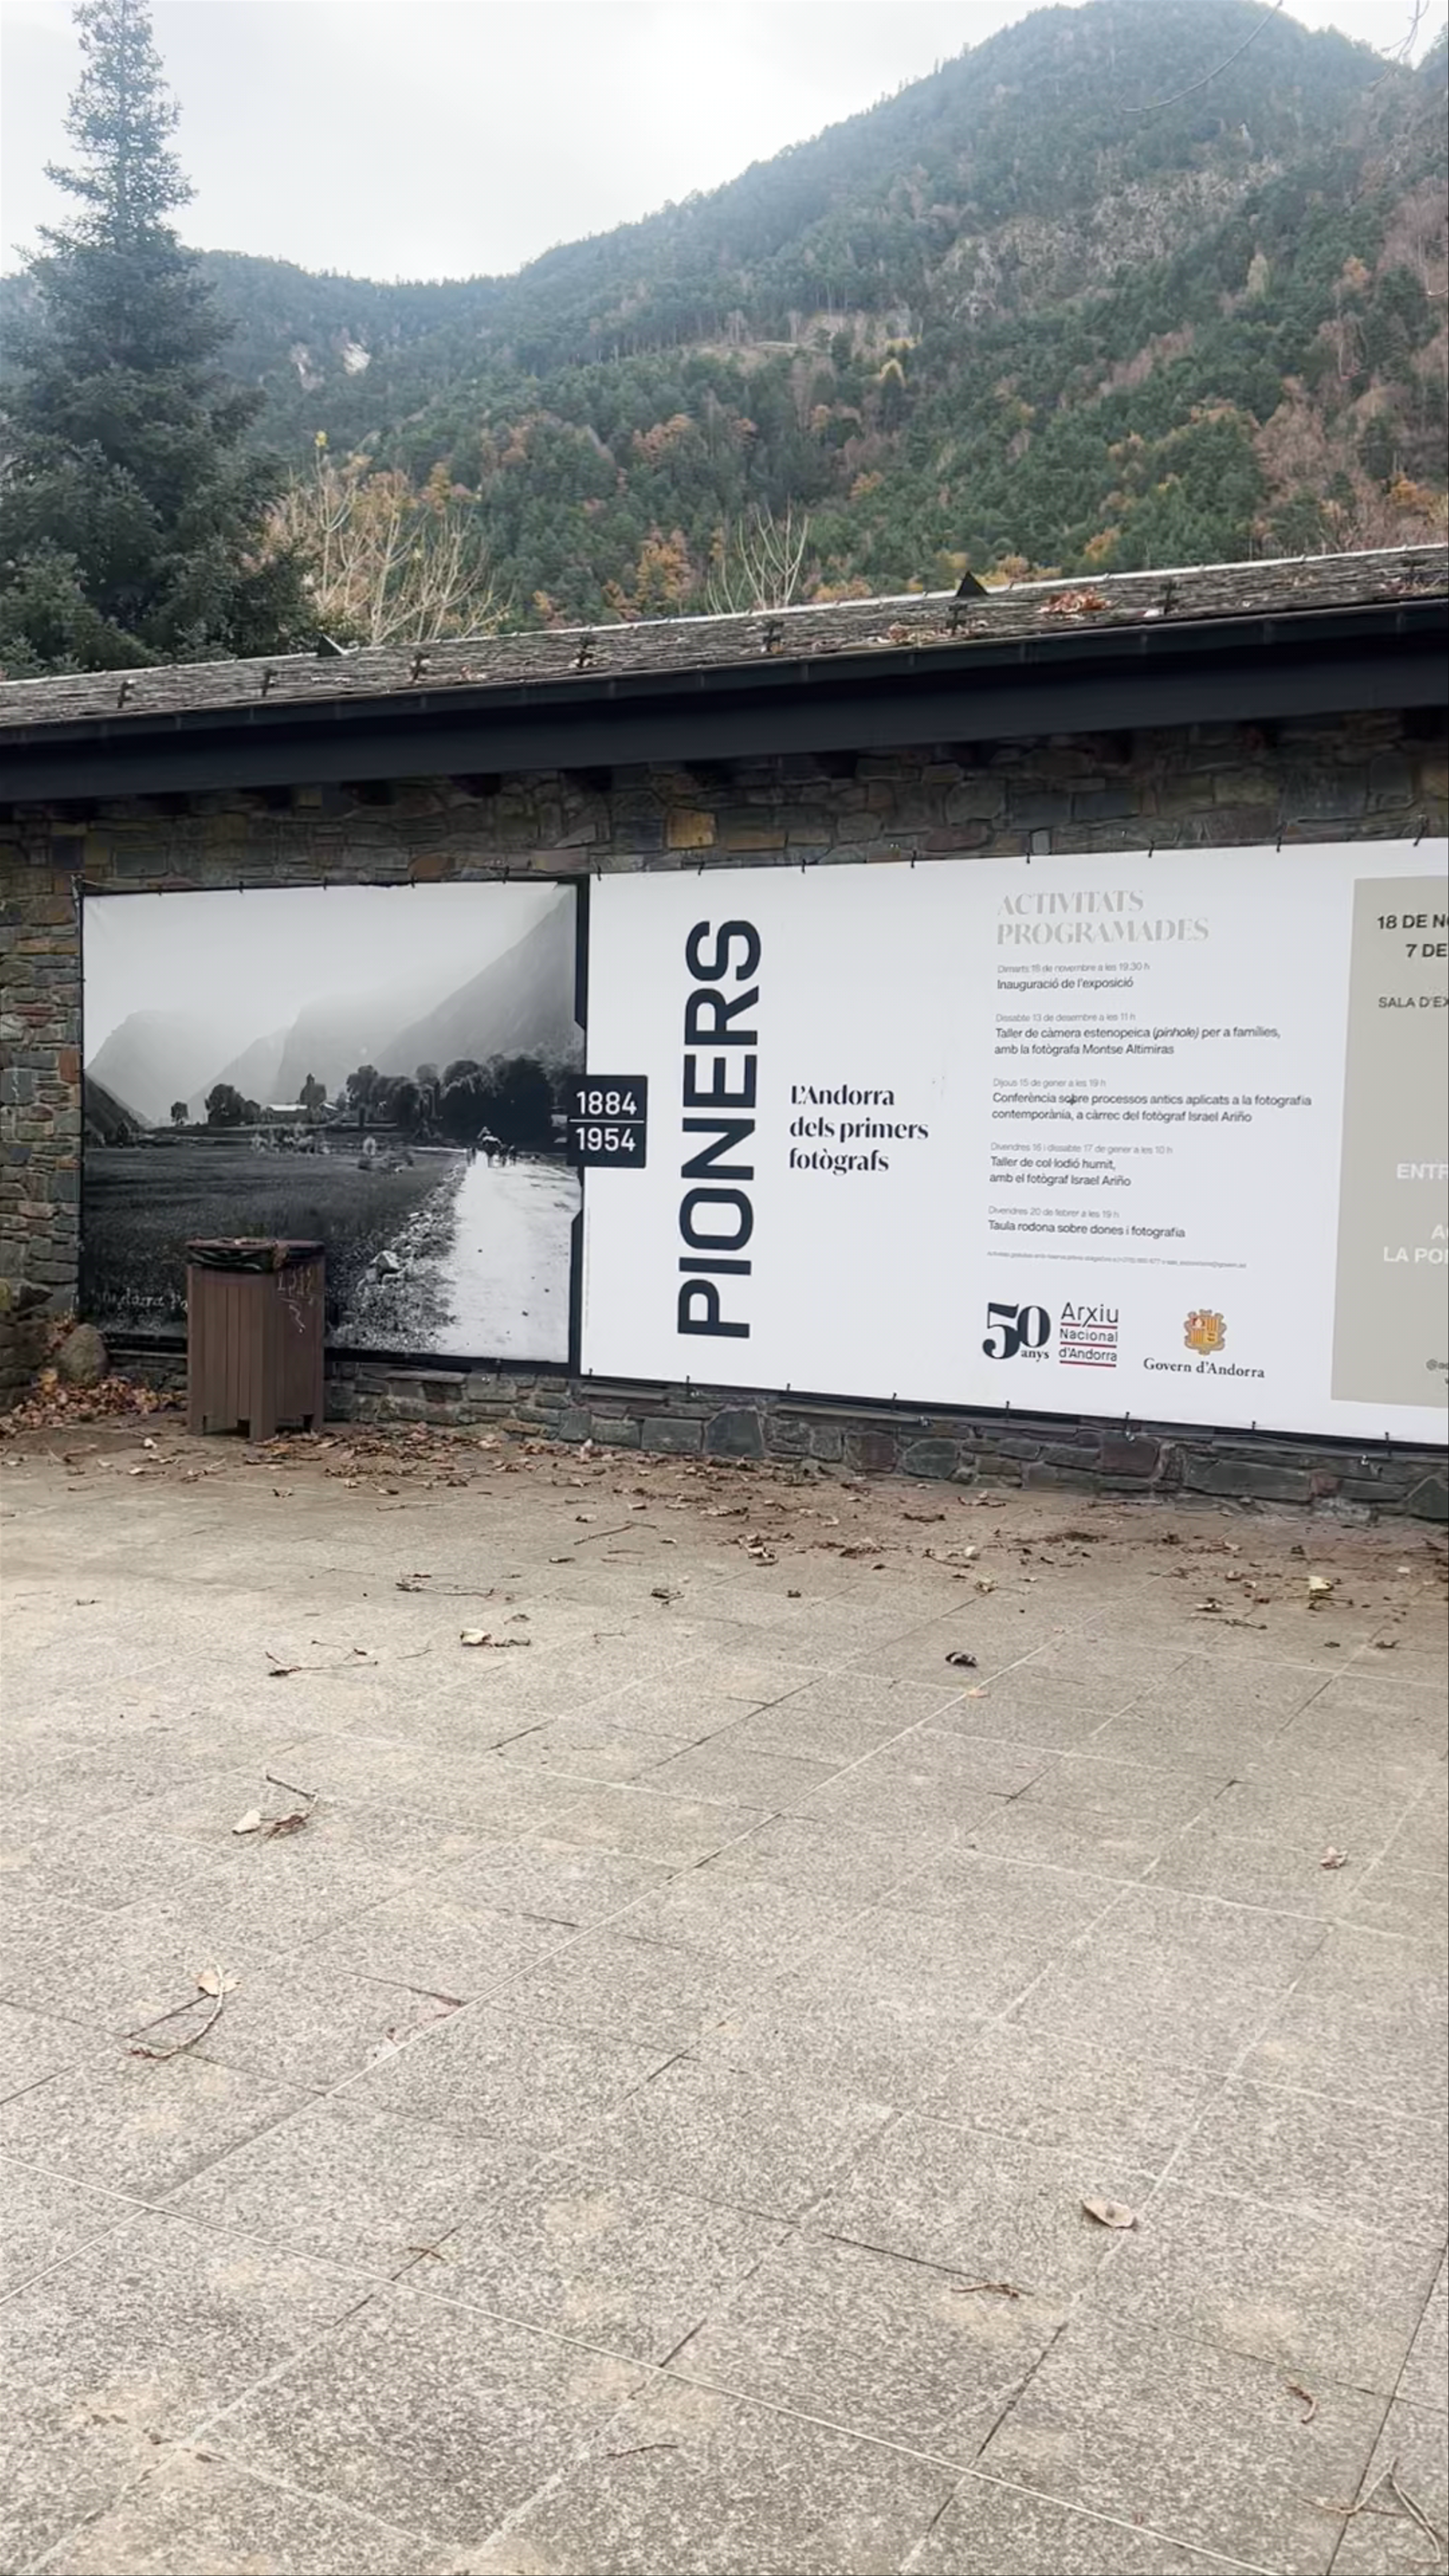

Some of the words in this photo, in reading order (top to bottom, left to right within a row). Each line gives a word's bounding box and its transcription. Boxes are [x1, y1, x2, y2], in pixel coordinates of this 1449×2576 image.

[998, 890, 1144, 916] ACTIVITATS
[1377, 915, 1397, 929] 18
[1403, 914, 1427, 928] DE
[1433, 914, 1448, 928] N
[997, 918, 1209, 944] PROGRAMADES
[1406, 944, 1417, 958] 7
[1422, 944, 1447, 957] DE
[1055, 964, 1095, 972] novembre
[1105, 963, 1116, 971] les
[1120, 963, 1141, 971] 19.30
[997, 978, 1058, 991] Inauguració
[1061, 980, 1075, 988] de
[1078, 976, 1133, 990] l'exposició
[1378, 997, 1415, 1008] SALA
[1057, 1013, 1097, 1021] desembre
[996, 1028, 1022, 1038] Taller
[1025, 1029, 1038, 1038] de
[1041, 1027, 1081, 1038] càmera
[1084, 1027, 1149, 1039] estenopeica
[1153, 1027, 1199, 1040] (pinhole)
[1201, 1028, 1220, 1039] per
[995, 1044, 1018, 1054] amb
[1021, 1044, 1029, 1054] la
[1032, 1044, 1080, 1057] fotògrafa
[1083, 1044, 1123, 1054] Montse
[1126, 1044, 1174, 1055] Altimiras
[993, 1078, 1018, 1088] Dijous
[1030, 1079, 1041, 1087] de
[1043, 1080, 1066, 1089] gener
[576, 1090, 637, 1115] 1884
[791, 1084, 894, 1106] L'Andorra
[992, 1092, 1056, 1103] Conferència
[1058, 1093, 1089, 1105] sobre
[1091, 1095, 1148, 1105] processos
[1150, 1094, 1183, 1105] antics
[1186, 1095, 1229, 1106] aplicats
[1232, 1097, 1240, 1105] a
[1242, 1095, 1252, 1106] la
[1255, 1095, 1312, 1108] fotografia
[992, 1109, 1074, 1121] contemporània,
[1086, 1109, 1120, 1120] càrrec
[1123, 1110, 1139, 1121] del
[1142, 1110, 1186, 1123] fotògraf
[1188, 1112, 1218, 1122] Israel
[1221, 1110, 1252, 1122] Ariño
[677, 920, 761, 1338] PIONERS
[790, 1116, 834, 1137] dels
[840, 1117, 928, 1143] primers
[576, 1127, 635, 1152] 1954
[991, 1142, 1030, 1152] Divendres
[1047, 1144, 1081, 1152] dissabte
[1095, 1144, 1105, 1153] de
[1108, 1146, 1131, 1155] gener
[1141, 1146, 1152, 1154] les
[1155, 1146, 1164, 1154] 10
[1166, 1146, 1172, 1154] h
[789, 1148, 889, 1175] fotògrafs
[991, 1156, 1017, 1166] Taller
[1020, 1157, 1033, 1167] de
[1082, 1158, 1116, 1170] humit,
[990, 1173, 1013, 1182] amb
[1015, 1173, 1025, 1183] el
[1027, 1173, 1068, 1186] fotògraf
[1071, 1175, 1099, 1185] Israel
[1102, 1174, 1132, 1186] Ariño
[989, 1206, 1028, 1215] Divendres
[1030, 1207, 1041, 1215] 20
[1043, 1207, 1053, 1216] de
[1055, 1208, 1079, 1218] febrer
[1088, 1209, 1100, 1218] les
[1102, 1210, 1111, 1218] 19
[1113, 1210, 1119, 1219] h
[988, 1220, 1016, 1230] Taula
[1018, 1221, 1055, 1233] rodona
[1057, 1223, 1088, 1234] sobre
[1090, 1224, 1123, 1235] dones
[1131, 1225, 1185, 1239] fotografia
[1431, 1224, 1448, 1240] A
[1383, 1246, 1409, 1263] LA
[1061, 1302, 1118, 1327] Arxiu
[982, 1302, 1051, 1359] 50
[1060, 1329, 1118, 1342] Nacional
[1021, 1350, 1049, 1362] anys
[1058, 1347, 1117, 1361] d'Andorra
[1144, 1358, 1191, 1372] Govern
[1196, 1361, 1265, 1378] d'Andorra
